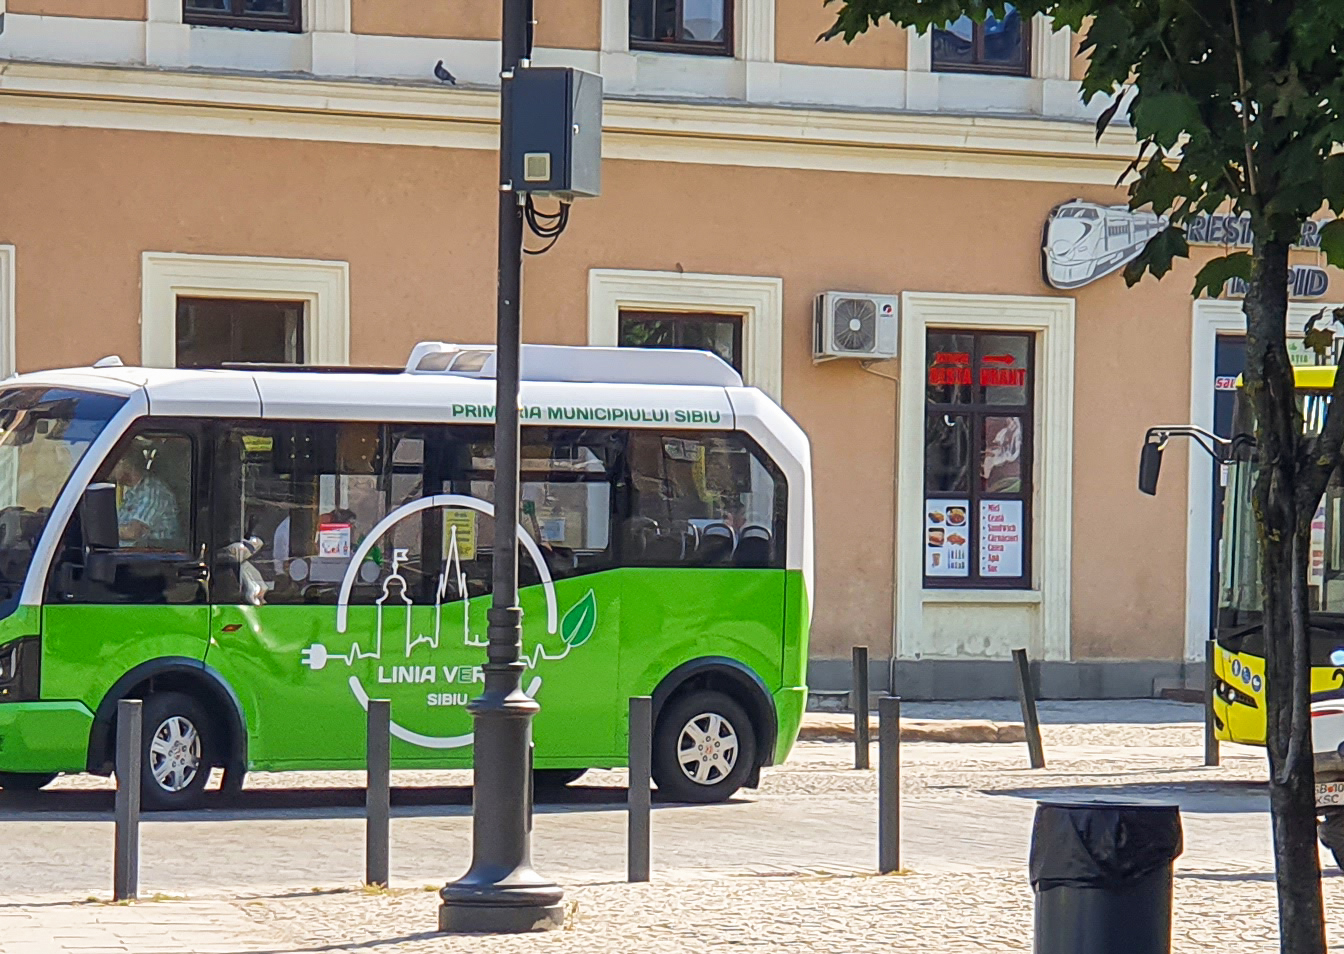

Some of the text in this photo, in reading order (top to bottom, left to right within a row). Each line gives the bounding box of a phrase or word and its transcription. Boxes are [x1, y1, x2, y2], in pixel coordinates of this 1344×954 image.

[547, 406, 669, 423] MUNICIPIULUI
[675, 409, 721, 424] SIBIU
[378, 665, 485, 684] LINIA VER
[427, 693, 468, 706] SIBIU
